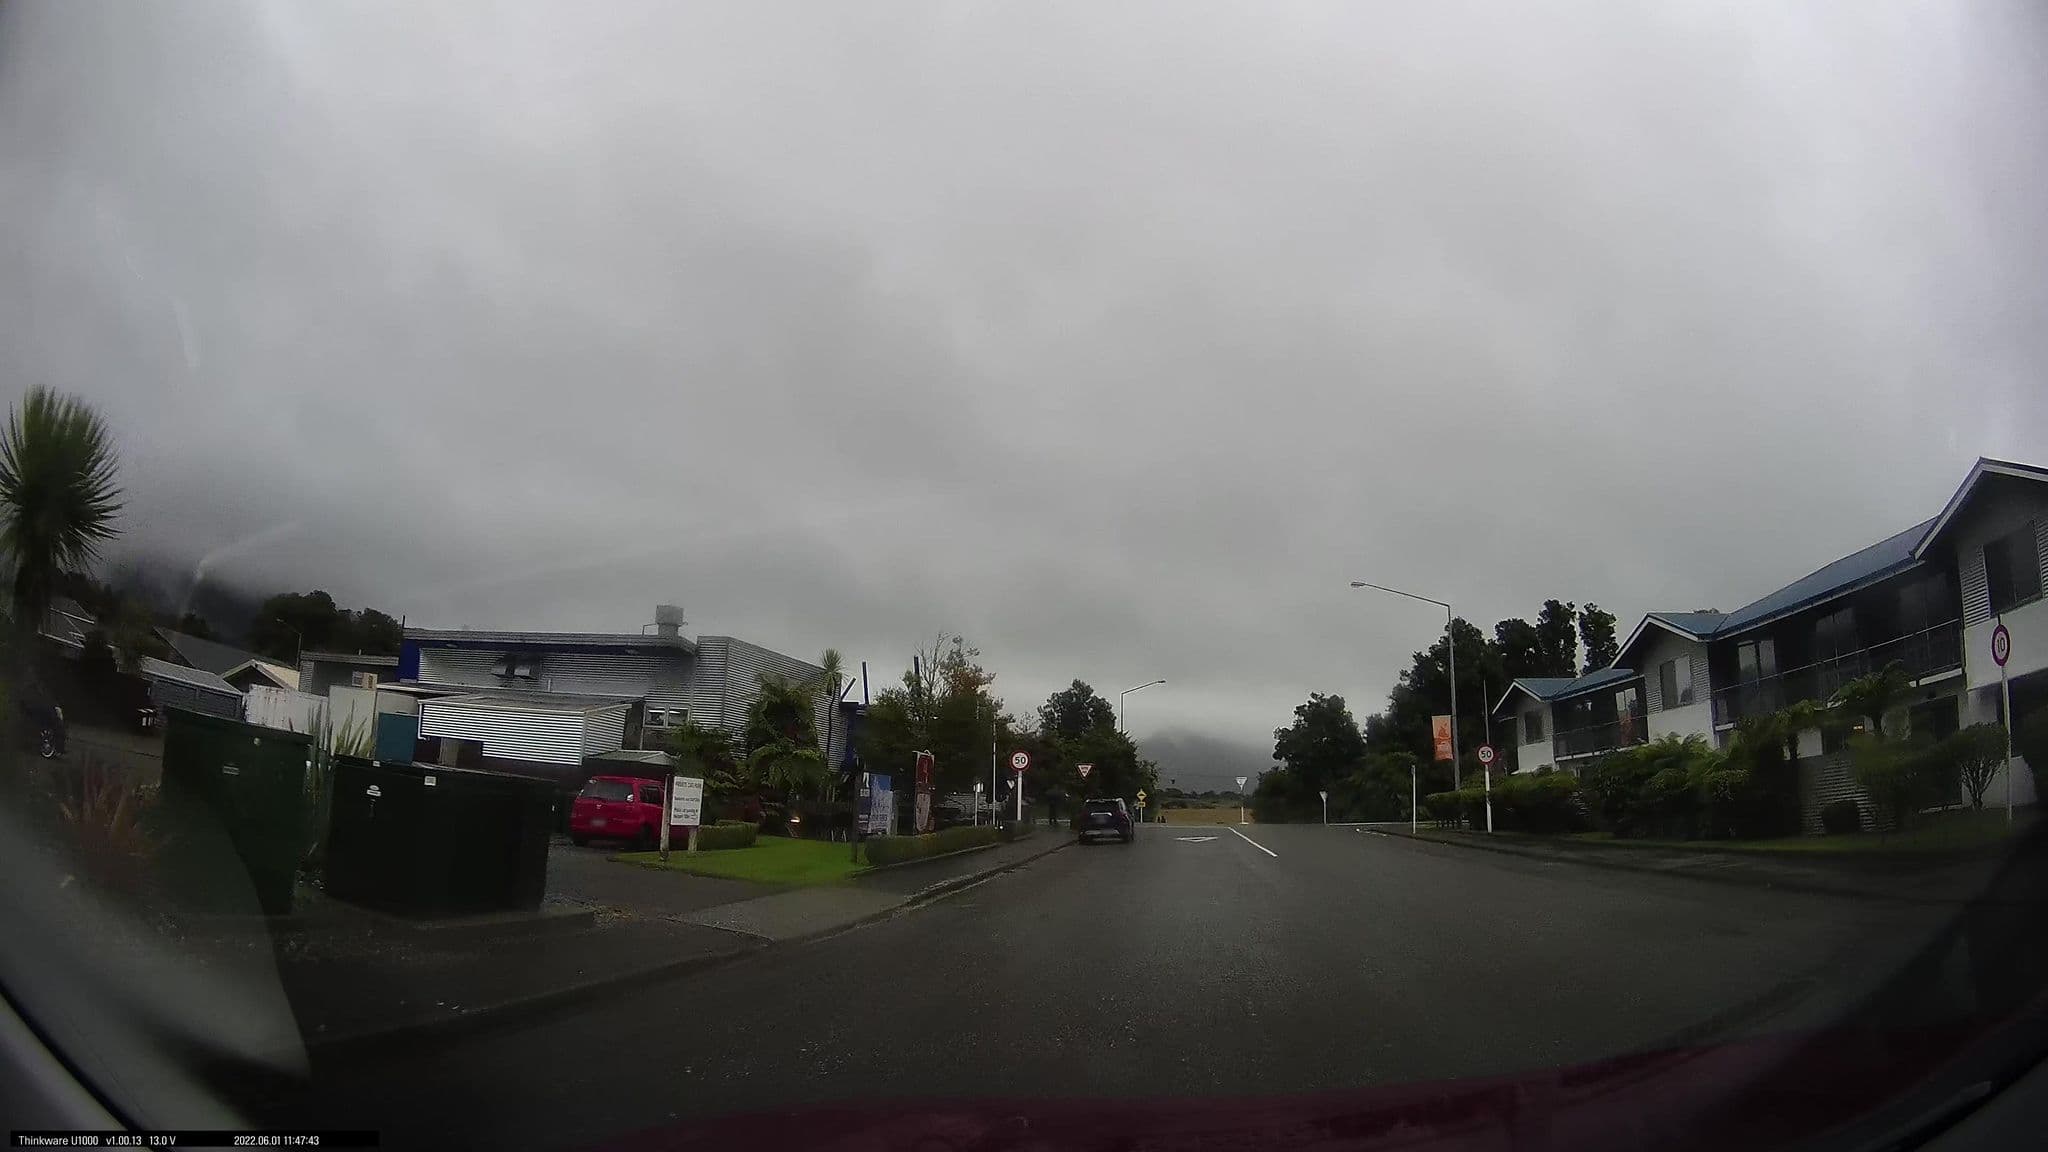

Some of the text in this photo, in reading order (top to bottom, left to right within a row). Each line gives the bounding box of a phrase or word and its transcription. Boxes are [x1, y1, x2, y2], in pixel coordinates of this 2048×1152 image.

[1997, 637, 2005, 653] 10
[1481, 750, 1491, 758] 50
[1015, 756, 1026, 764] 50
